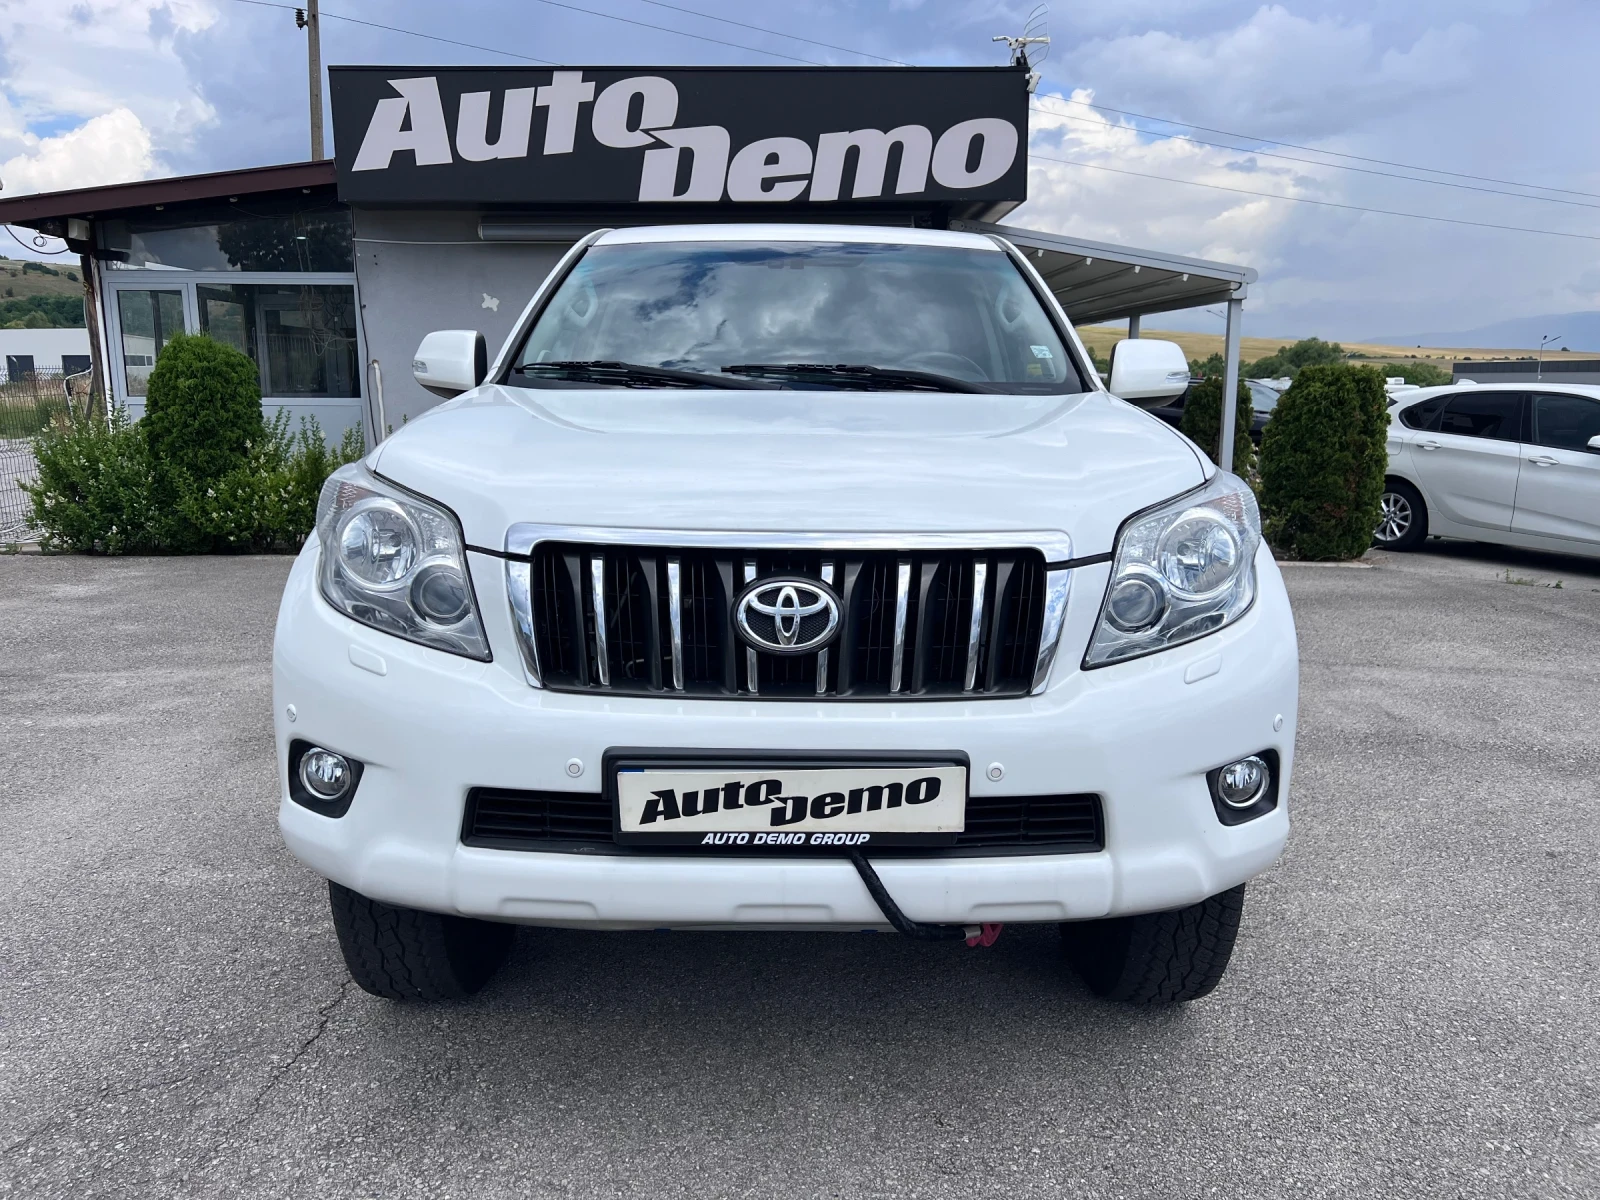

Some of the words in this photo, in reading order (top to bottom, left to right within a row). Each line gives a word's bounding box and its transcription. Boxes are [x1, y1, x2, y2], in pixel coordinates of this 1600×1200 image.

[352, 71, 679, 172] Auto
[638, 118, 1019, 202] Demo
[639, 779, 782, 826] Auto
[769, 776, 942, 826] Demo
[701, 832, 750, 846] AUTO
[753, 832, 806, 846] DEMO
[809, 832, 871, 846] GROUP
